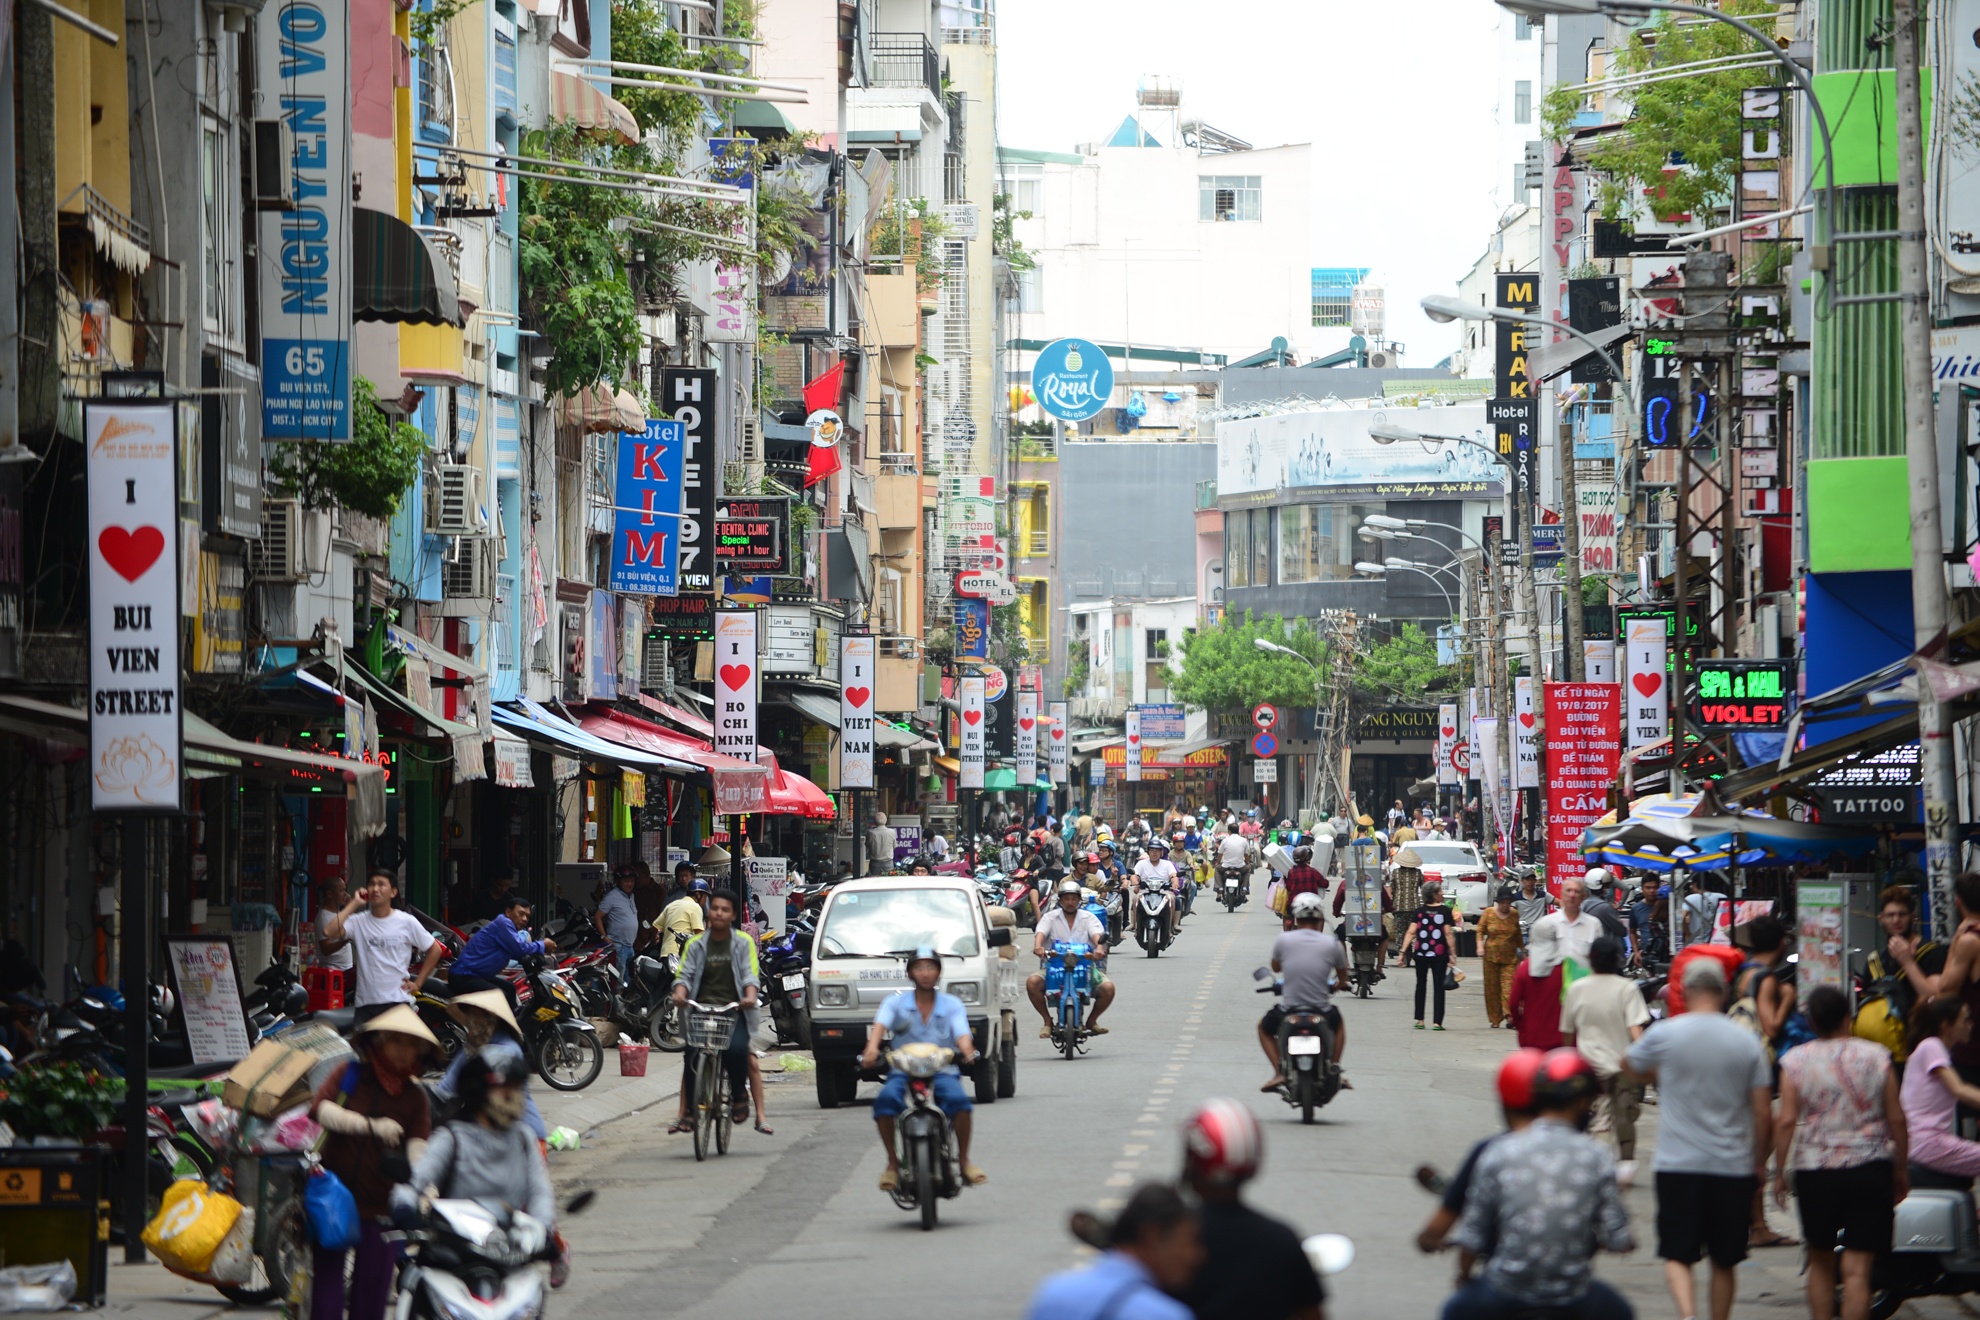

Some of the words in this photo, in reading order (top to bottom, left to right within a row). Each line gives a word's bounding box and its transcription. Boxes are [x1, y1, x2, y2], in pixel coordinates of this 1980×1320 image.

[279, 8, 327, 81] VO
[280, 97, 329, 315] NGUYEN
[795, 286, 829, 296] fitness
[1507, 282, 1533, 398] MRAK
[285, 346, 325, 376] 65
[280, 382, 293, 393] BUI
[294, 382, 311, 393] VIEN
[1039, 369, 1107, 409] Royal
[266, 398, 287, 409] PHAM
[305, 399, 320, 410] LAO
[1493, 406, 1528, 418] Hotel
[272, 414, 295, 425] DIST.1
[303, 415, 319, 426] HCM
[320, 416, 337, 427] CITY
[624, 423, 680, 442] otel
[675, 378, 702, 514] HOTEL
[125, 478, 136, 504] I
[623, 443, 669, 569] KIM
[721, 523, 746, 535] DENTAL
[748, 523, 769, 535] CLINIC
[680, 519, 701, 570] 97
[721, 535, 750, 546] Special
[753, 545, 770, 555] hour
[616, 571, 626, 580] 91
[658, 574, 670, 584] Q.1
[685, 574, 709, 586] VIEN
[963, 579, 999, 588] HOTEL
[611, 582, 624, 591] TEL
[658, 585, 674, 594] 8584
[654, 599, 679, 613] SHOP
[682, 598, 705, 613] HAIR
[113, 606, 152, 631] BUI
[676, 618, 694, 628] NAM
[962, 609, 983, 653] Tiger
[731, 642, 739, 655] I
[107, 647, 160, 673] VIEN
[1644, 652, 1650, 664] I
[854, 665, 861, 677] I
[1595, 665, 1601, 675] I
[1700, 671, 1732, 698] SPA
[1733, 676, 1745, 699] &
[1584, 687, 1611, 698] NGÀY
[95, 690, 173, 715] STREET
[725, 701, 745, 713] HO
[971, 697, 975, 705] I
[1526, 697, 1531, 706] I
[1556, 701, 1609, 710] 19/8/2017
[1639, 708, 1657, 720] BUI
[1701, 704, 1783, 723] VIOLET
[723, 718, 748, 729] CHI
[843, 717, 872, 730] VIET
[967, 732, 978, 740] BUI
[1560, 724, 1579, 736] BÙI
[1580, 724, 1606, 737] VIỆN
[1636, 726, 1660, 738] VIEN
[718, 735, 754, 746] MINH
[1548, 741, 1574, 750] ĐOẠN
[844, 741, 870, 754] NAM
[965, 743, 980, 751] VIEN
[961, 755, 983, 763] STREET
[1188, 746, 1227, 764] POSTERS
[1578, 752, 1605, 763] THÁM
[1558, 764, 1578, 775] ĐẾN
[1566, 780, 1597, 789] QUANG
[1561, 792, 1607, 811] CẤM
[1833, 798, 1905, 813] TATTOO
[1549, 813, 1567, 824] CÁC
[900, 827, 919, 839] SPA
[895, 840, 912, 848] SAGE
[750, 861, 759, 874] G
[759, 866, 774, 874] Quốc
[1552, 874, 1563, 885] VÀ
